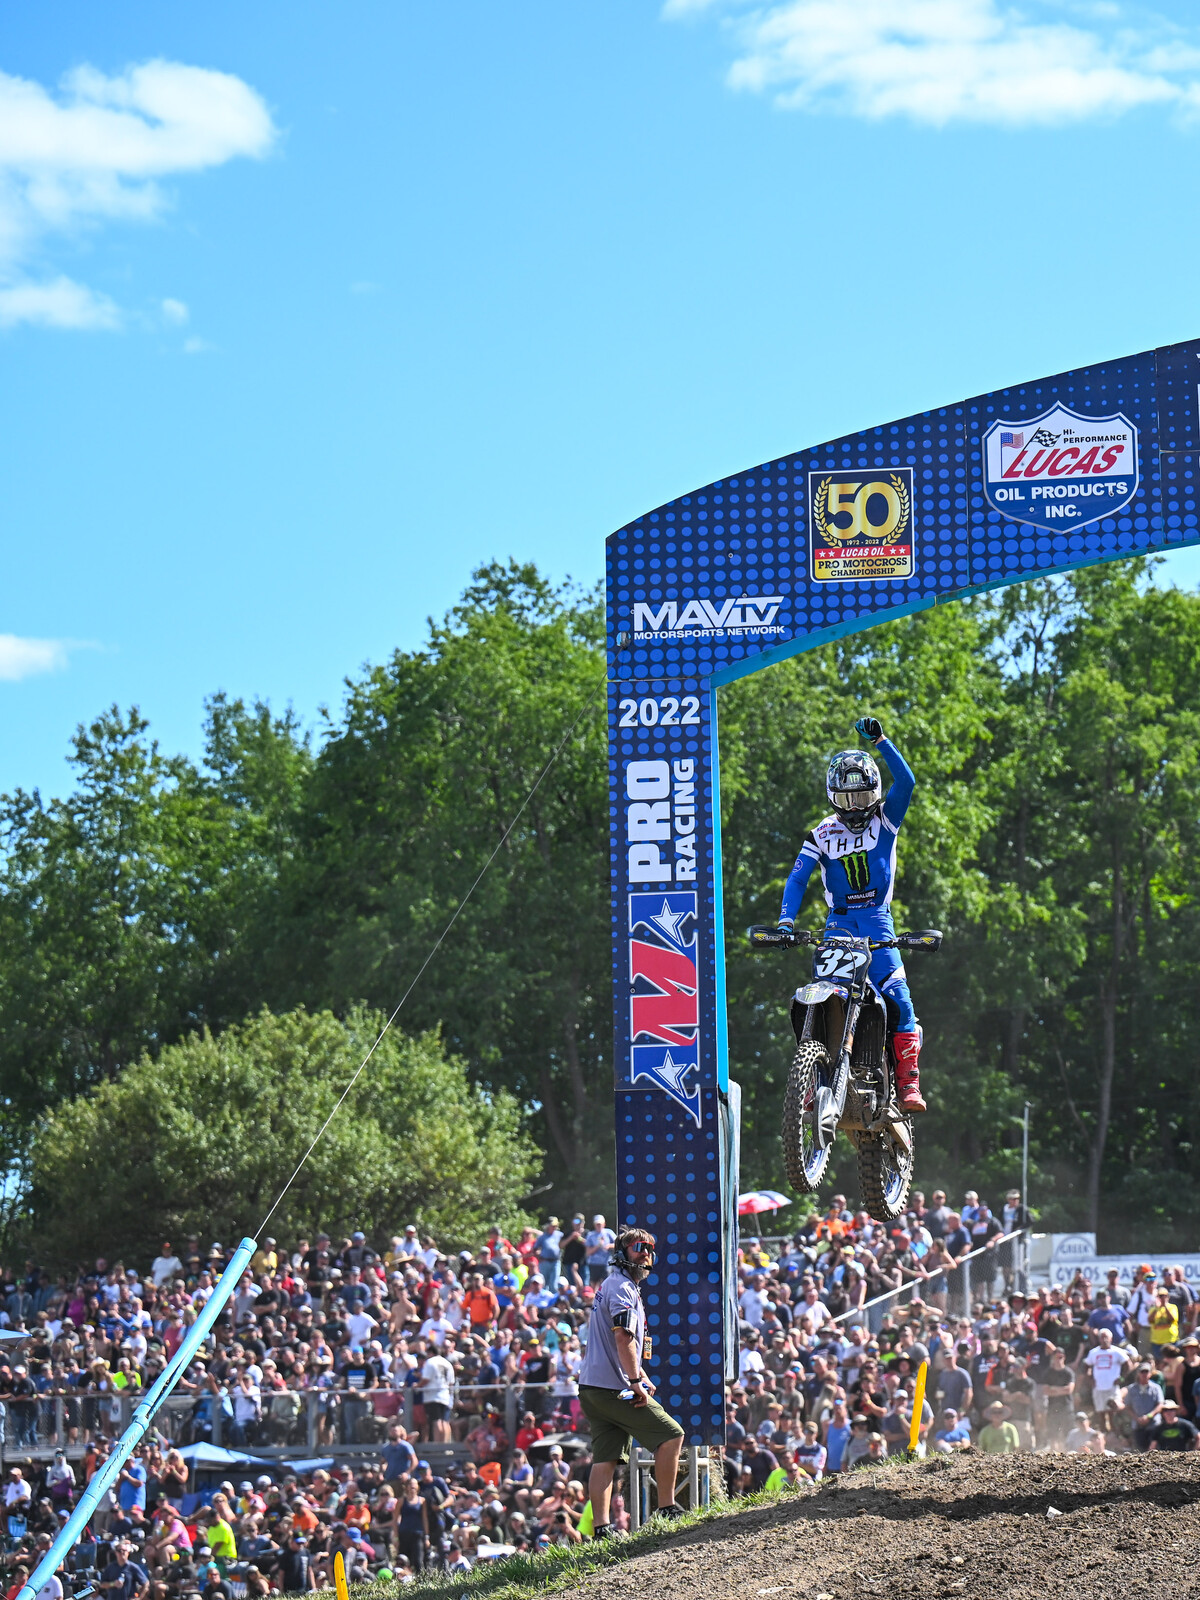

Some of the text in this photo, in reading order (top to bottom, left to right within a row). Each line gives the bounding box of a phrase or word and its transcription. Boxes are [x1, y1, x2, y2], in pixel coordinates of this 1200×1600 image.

[1063, 434, 1127, 444] PERFORMANCE
[1002, 444, 1125, 479] LUCAS
[995, 482, 1128, 502] OIL PRODUCTS
[825, 481, 901, 540] 50
[818, 557, 907, 569] PRO MOTOCROSS
[840, 547, 885, 557] LUCAS OIL
[831, 568, 895, 577] CHAMPIONSHIP
[634, 625, 785, 640] MOTORSPORTS NETWORK
[618, 696, 700, 728] 2022
[627, 760, 672, 883] PRO
[673, 758, 697, 881] RACING
[816, 948, 868, 979] 32
[628, 891, 702, 1129] AMA
[834, 1062, 846, 1101] DUNLOP
[1056, 1266, 1100, 1281] GYOS
